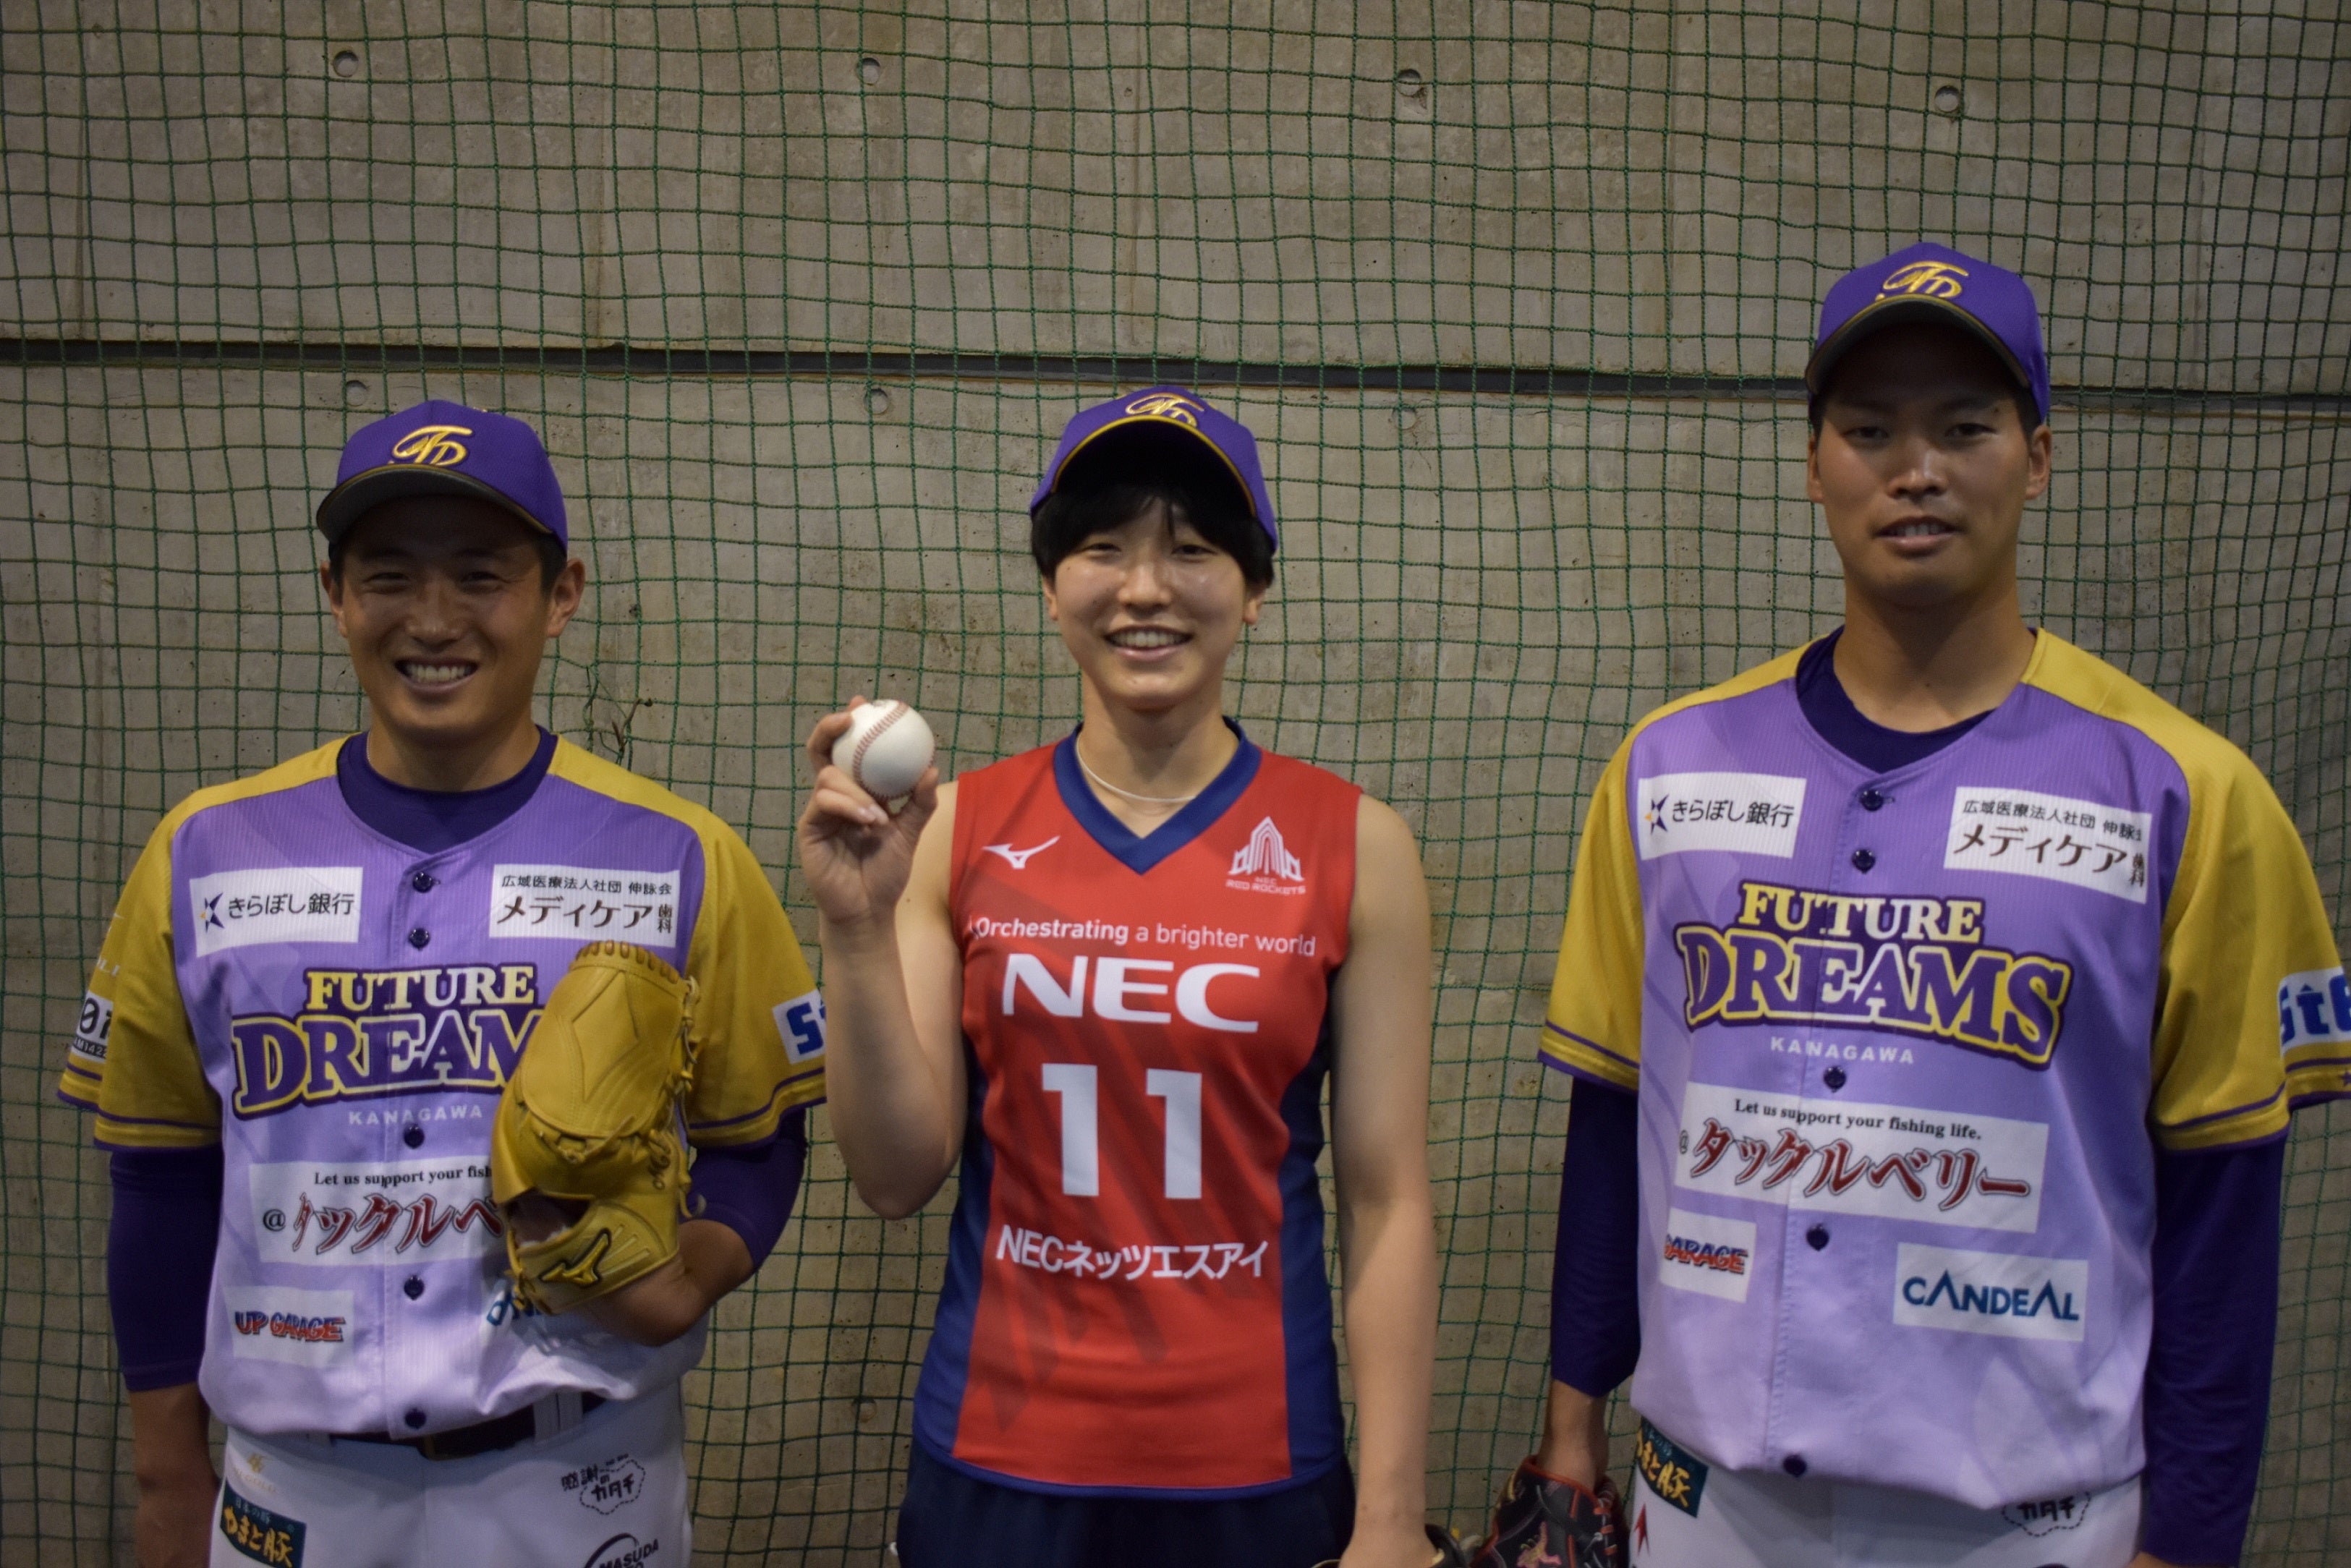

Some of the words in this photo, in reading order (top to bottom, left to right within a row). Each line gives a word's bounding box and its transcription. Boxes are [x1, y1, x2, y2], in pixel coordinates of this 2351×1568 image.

[1672, 799, 1795, 829] きらぼし銀行
[1963, 800, 2096, 830] 広域医療法人社団
[1953, 823, 2127, 874] メディケア
[501, 874, 622, 894] 広域医療法人社団
[227, 892, 354, 919] きらぼし銀行
[497, 895, 653, 929] メディケア
[657, 903, 673, 934] 歯科
[1738, 882, 1983, 942] FUTURE
[1136, 926, 1149, 942] a
[1157, 922, 1249, 950] brighter
[1255, 935, 1316, 957] world
[306, 965, 535, 1011] FUTURE
[1003, 953, 1260, 1033] NEC
[1675, 926, 2072, 1065] DREAMS
[231, 1010, 544, 1116] DREAM
[1771, 1036, 1914, 1065] KANAGAWA
[349, 1105, 483, 1126] KANAGAWA
[1042, 1063, 1202, 1200] 11
[1735, 1098, 1759, 1114] Let
[1763, 1103, 1777, 1117] us
[1780, 1106, 1841, 1126] support
[1847, 1114, 1884, 1130] your
[1889, 1116, 1944, 1139] fishing
[1951, 1122, 1982, 1141] life.
[314, 1172, 339, 1185] Let
[344, 1174, 360, 1185] us
[365, 1171, 424, 1188] support
[428, 1167, 463, 1185] your
[467, 1165, 492, 1178] fish
[996, 1224, 1269, 1279] NECネッツエスアイ
[1903, 1269, 2080, 1321] CANDEAL
[235, 1311, 268, 1335] UP
[270, 1311, 347, 1342] GARAGE
